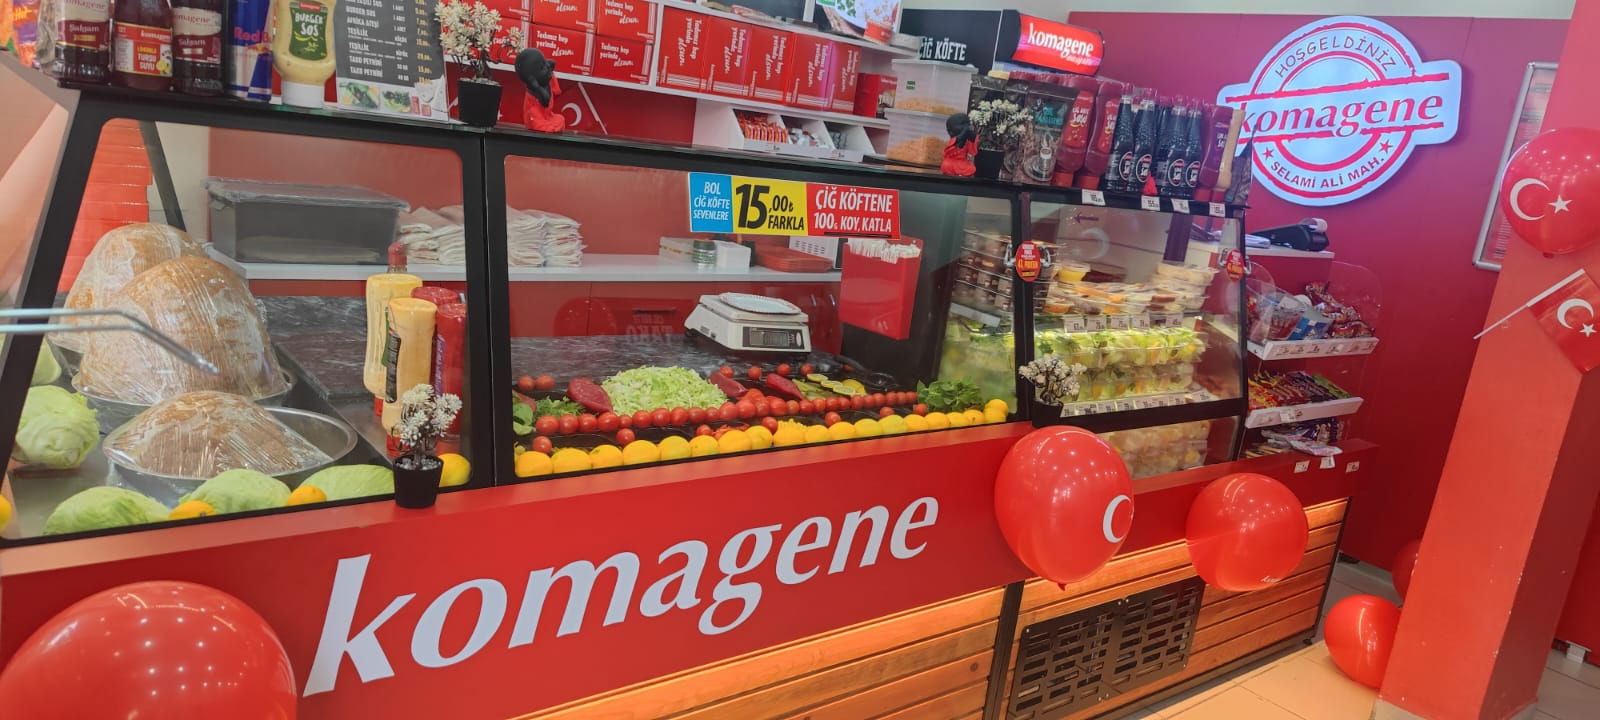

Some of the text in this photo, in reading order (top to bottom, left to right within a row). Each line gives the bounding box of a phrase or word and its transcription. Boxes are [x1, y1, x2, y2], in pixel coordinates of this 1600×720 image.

[295, 12, 323, 25] BURGER
[234, 27, 260, 41] Red
[301, 23, 319, 36] SOS
[1028, 22, 1094, 58] komagene
[935, 37, 967, 61] KÖFTE
[1275, 35, 1397, 78] HOŞGELDİNİZ
[1320, 173, 1344, 188] ALİ
[1347, 157, 1385, 183] MAH.
[704, 181, 721, 195] BOL
[693, 194, 730, 210] ÇİĞ KÖFTE
[815, 186, 893, 213] ÇİĞ KÖFTENE
[693, 210, 729, 221] SEVENLERE
[768, 214, 805, 231] FARKLA
[862, 216, 892, 233] KATLA
[303, 496, 938, 697] komagene
